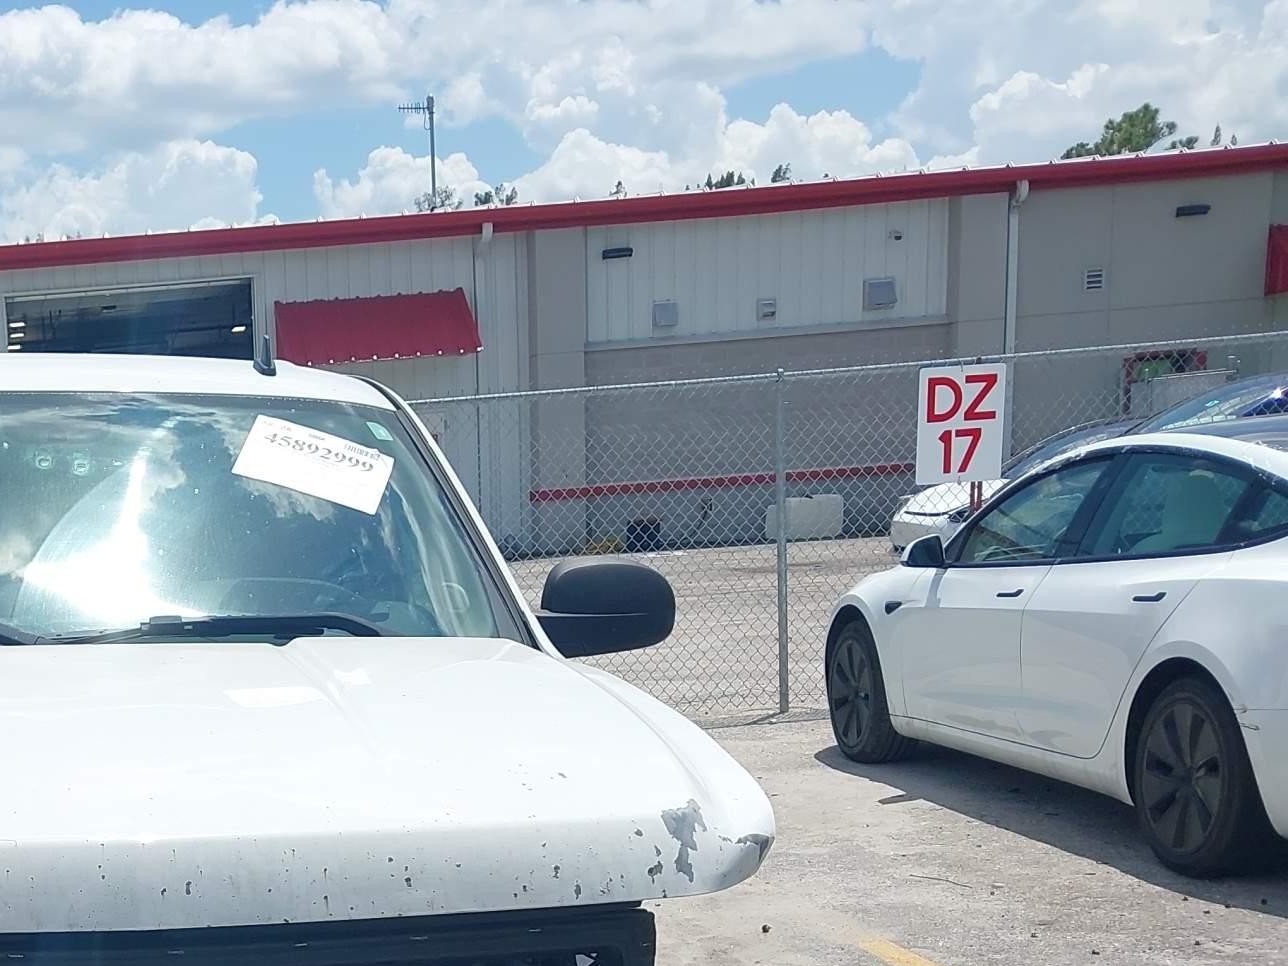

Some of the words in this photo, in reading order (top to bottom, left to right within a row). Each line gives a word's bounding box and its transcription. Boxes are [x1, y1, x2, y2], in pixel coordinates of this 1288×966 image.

[926, 373, 998, 423] DZ
[264, 433, 374, 472] 45892999
[938, 427, 982, 474] 17
